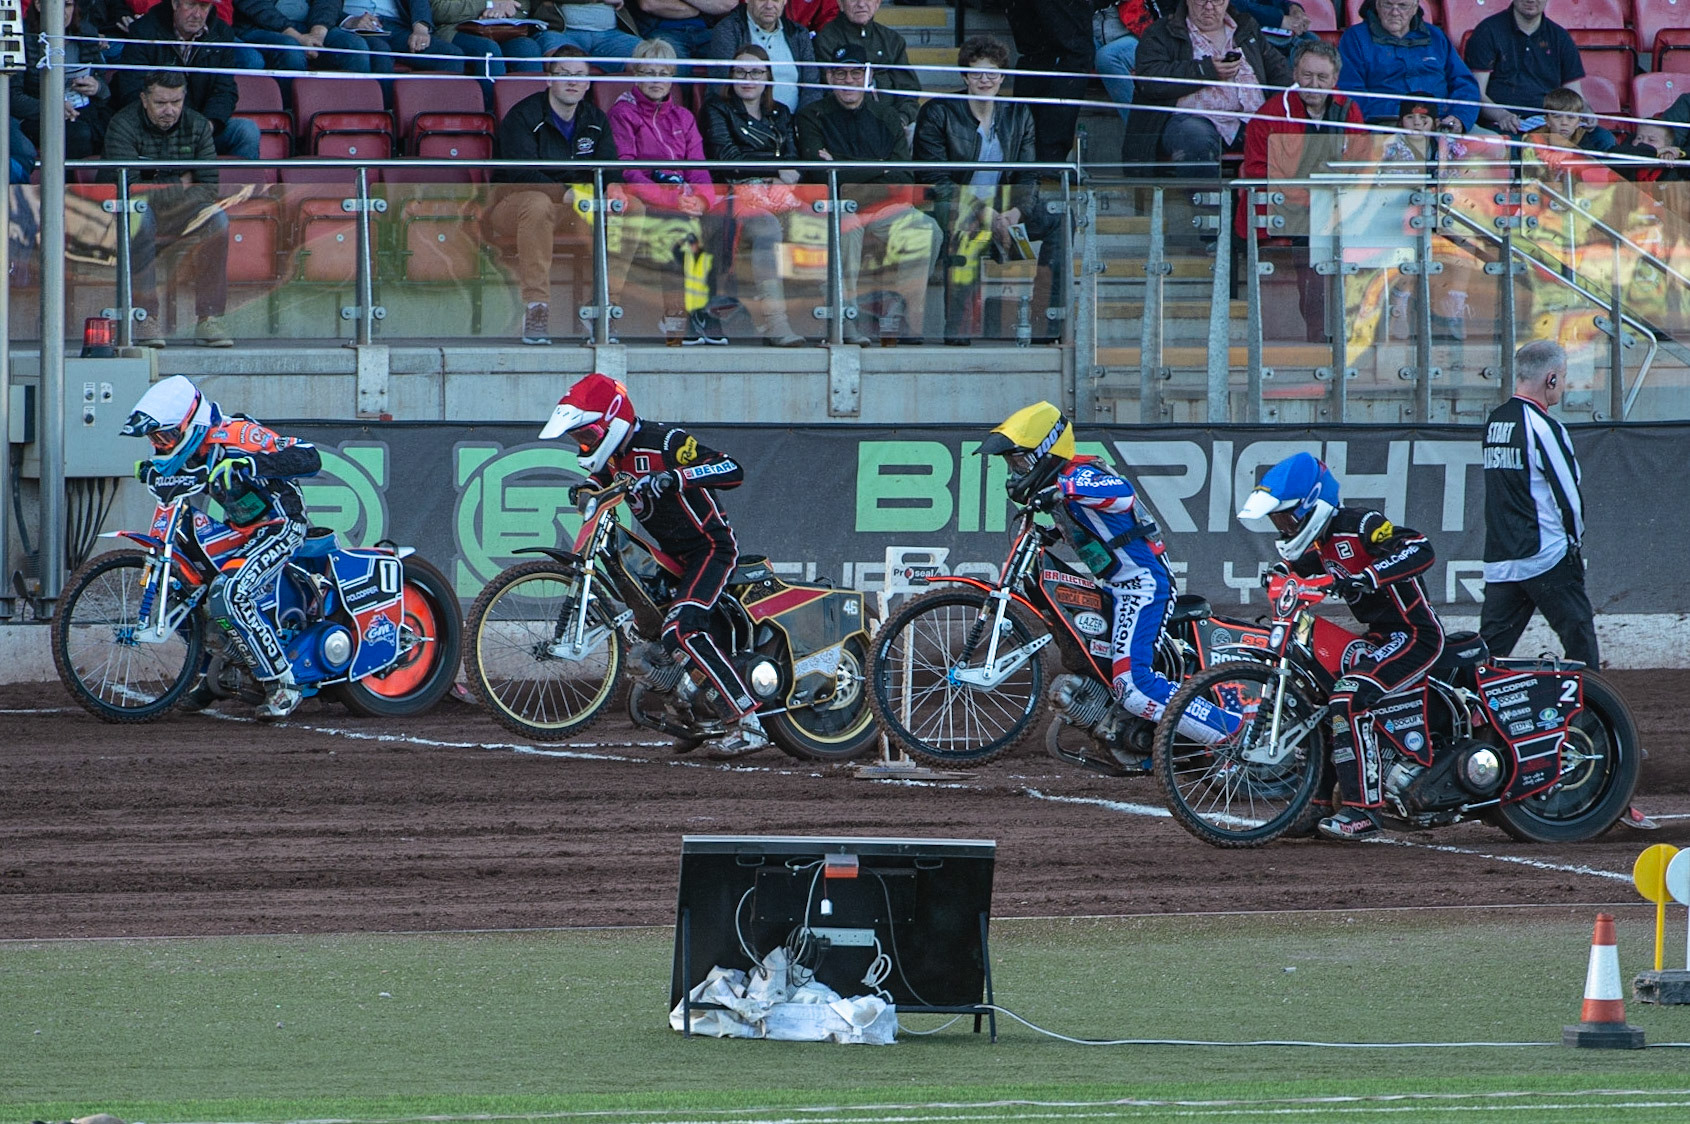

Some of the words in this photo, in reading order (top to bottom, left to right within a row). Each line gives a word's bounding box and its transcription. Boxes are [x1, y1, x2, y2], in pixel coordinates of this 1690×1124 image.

[1486, 421, 1516, 444] START
[1061, 573, 1096, 589] ELECTRIC
[346, 585, 379, 602] POLCOPPER
[843, 600, 859, 615] 46
[1116, 594, 1141, 655] HAGON
[1485, 678, 1538, 697] POLCOPPER
[1560, 680, 1578, 702] 2
[1372, 699, 1424, 716] POLCOPPER
